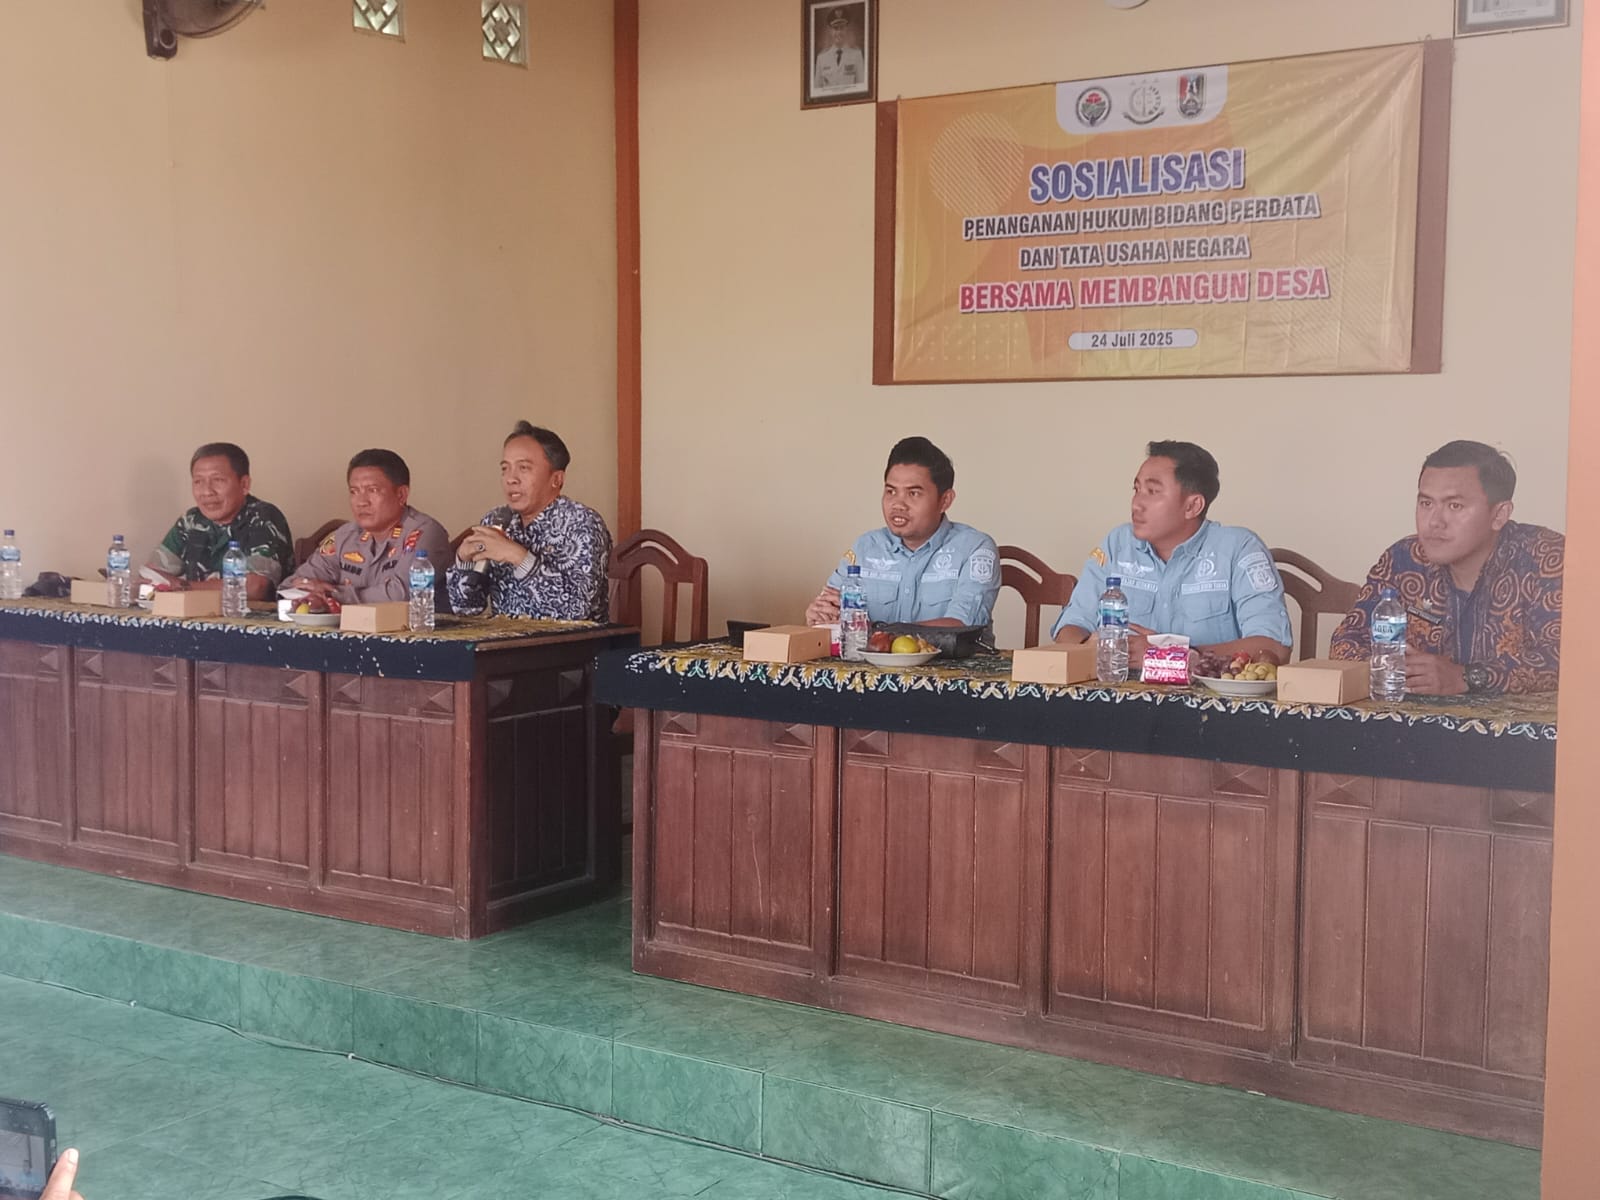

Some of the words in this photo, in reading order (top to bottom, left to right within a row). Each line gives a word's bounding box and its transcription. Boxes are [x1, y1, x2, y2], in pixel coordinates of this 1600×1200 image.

[1030, 149, 1244, 201] SOSIALISASI
[963, 210, 1077, 238] PENANGANAN
[1081, 206, 1148, 230] HUKUM
[1153, 201, 1226, 226] BIDANG
[1230, 194, 1319, 221] PERDATA
[1020, 247, 1055, 268] DAN
[1060, 245, 1101, 265] TATA
[1106, 240, 1168, 263] USAHA
[1172, 235, 1248, 259] NEGARA
[960, 280, 1074, 311] BERSAMA
[1080, 271, 1248, 306] MEMBANGUN
[1256, 267, 1329, 298] DESA
[1091, 334, 1108, 348] 24
[1111, 333, 1136, 347] Juli
[1139, 331, 1174, 346] 2025
